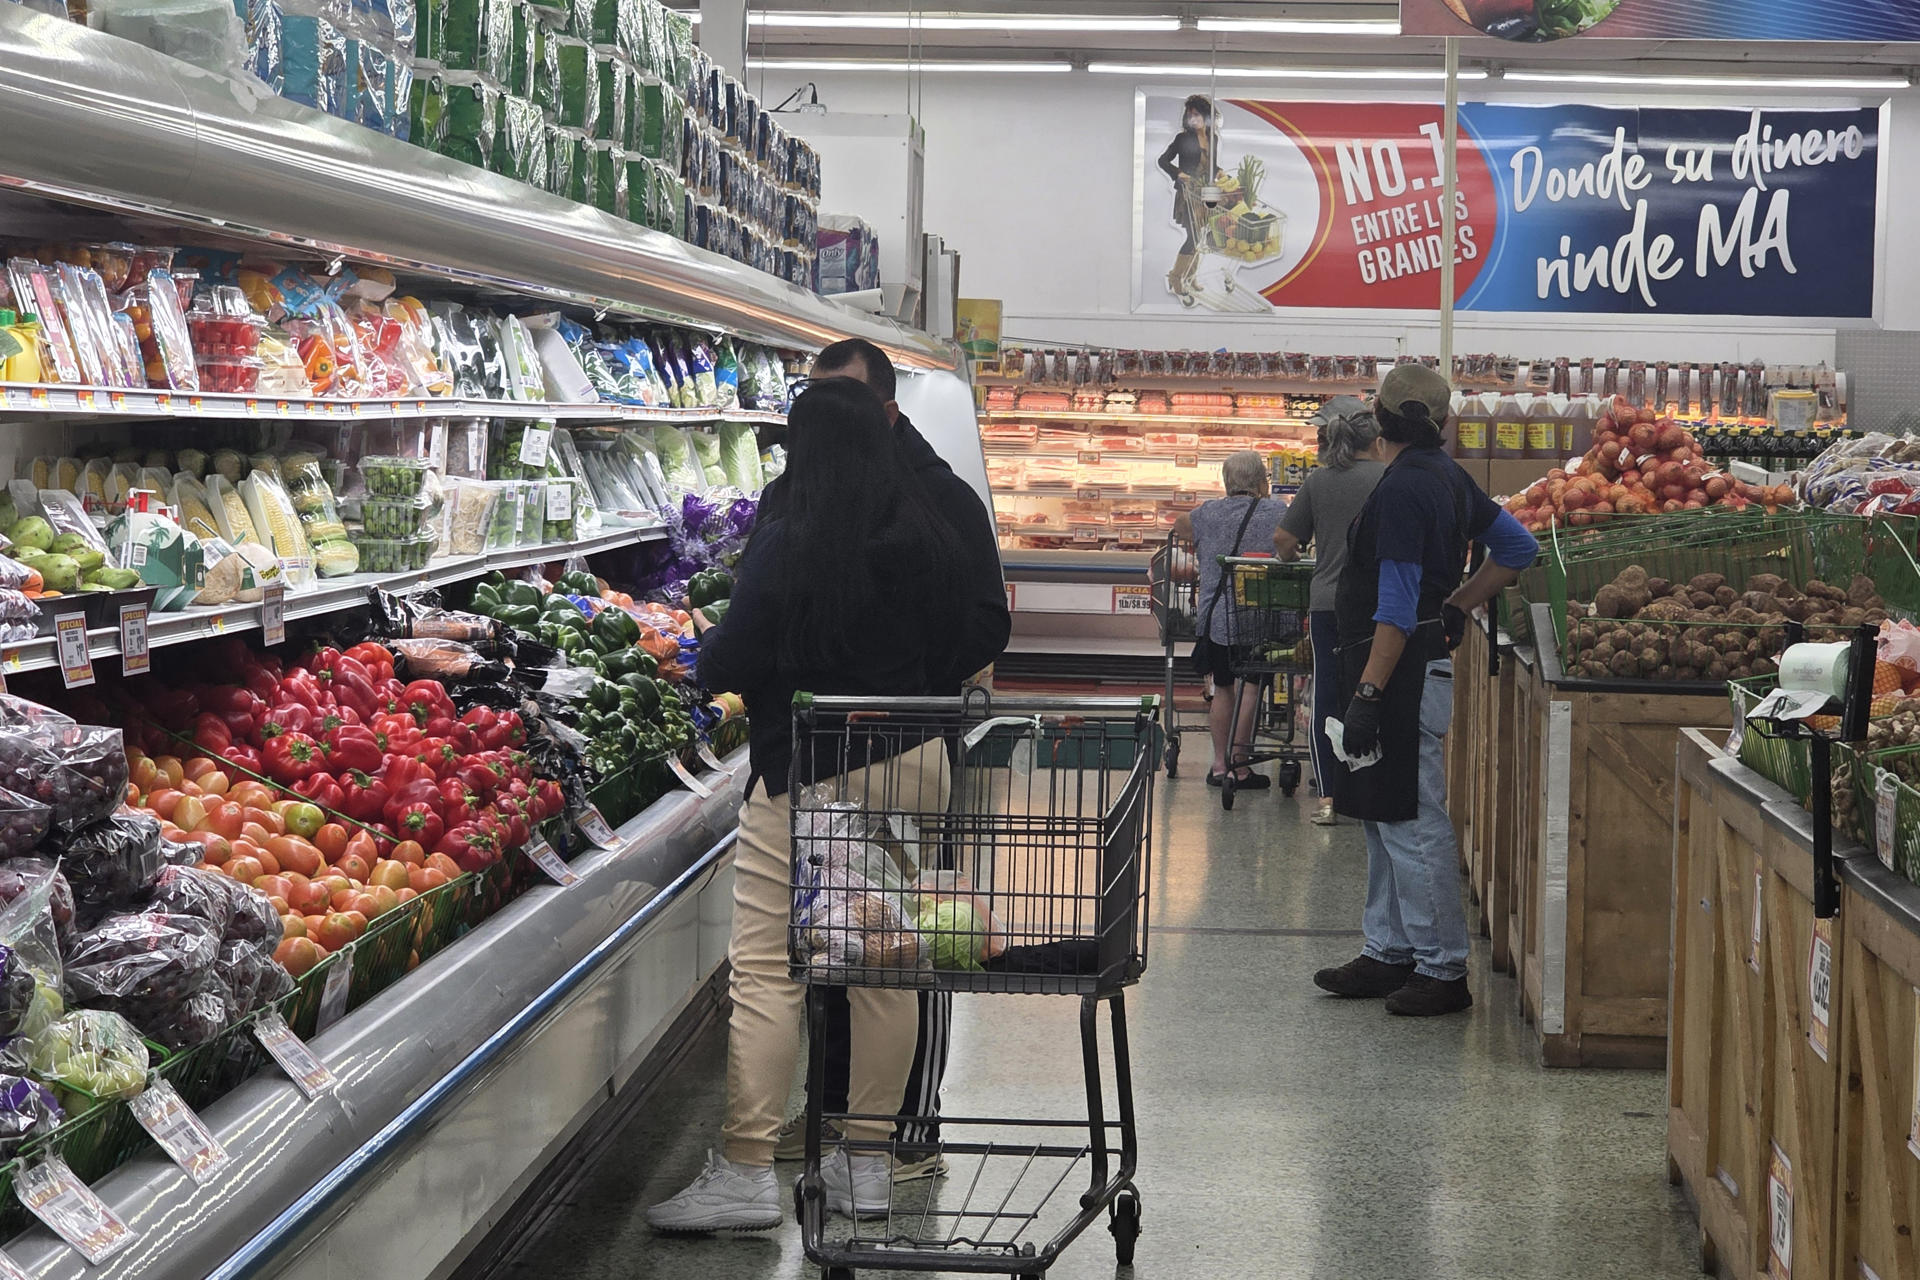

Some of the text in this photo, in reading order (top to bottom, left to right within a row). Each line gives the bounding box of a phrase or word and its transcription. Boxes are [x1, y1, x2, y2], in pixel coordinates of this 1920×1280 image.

[1335, 122, 1458, 205] NO.1
[1510, 109, 1864, 212] Donde su dinero
[1351, 203, 1422, 246] ENTRE
[1537, 187, 1797, 307] rinde MA
